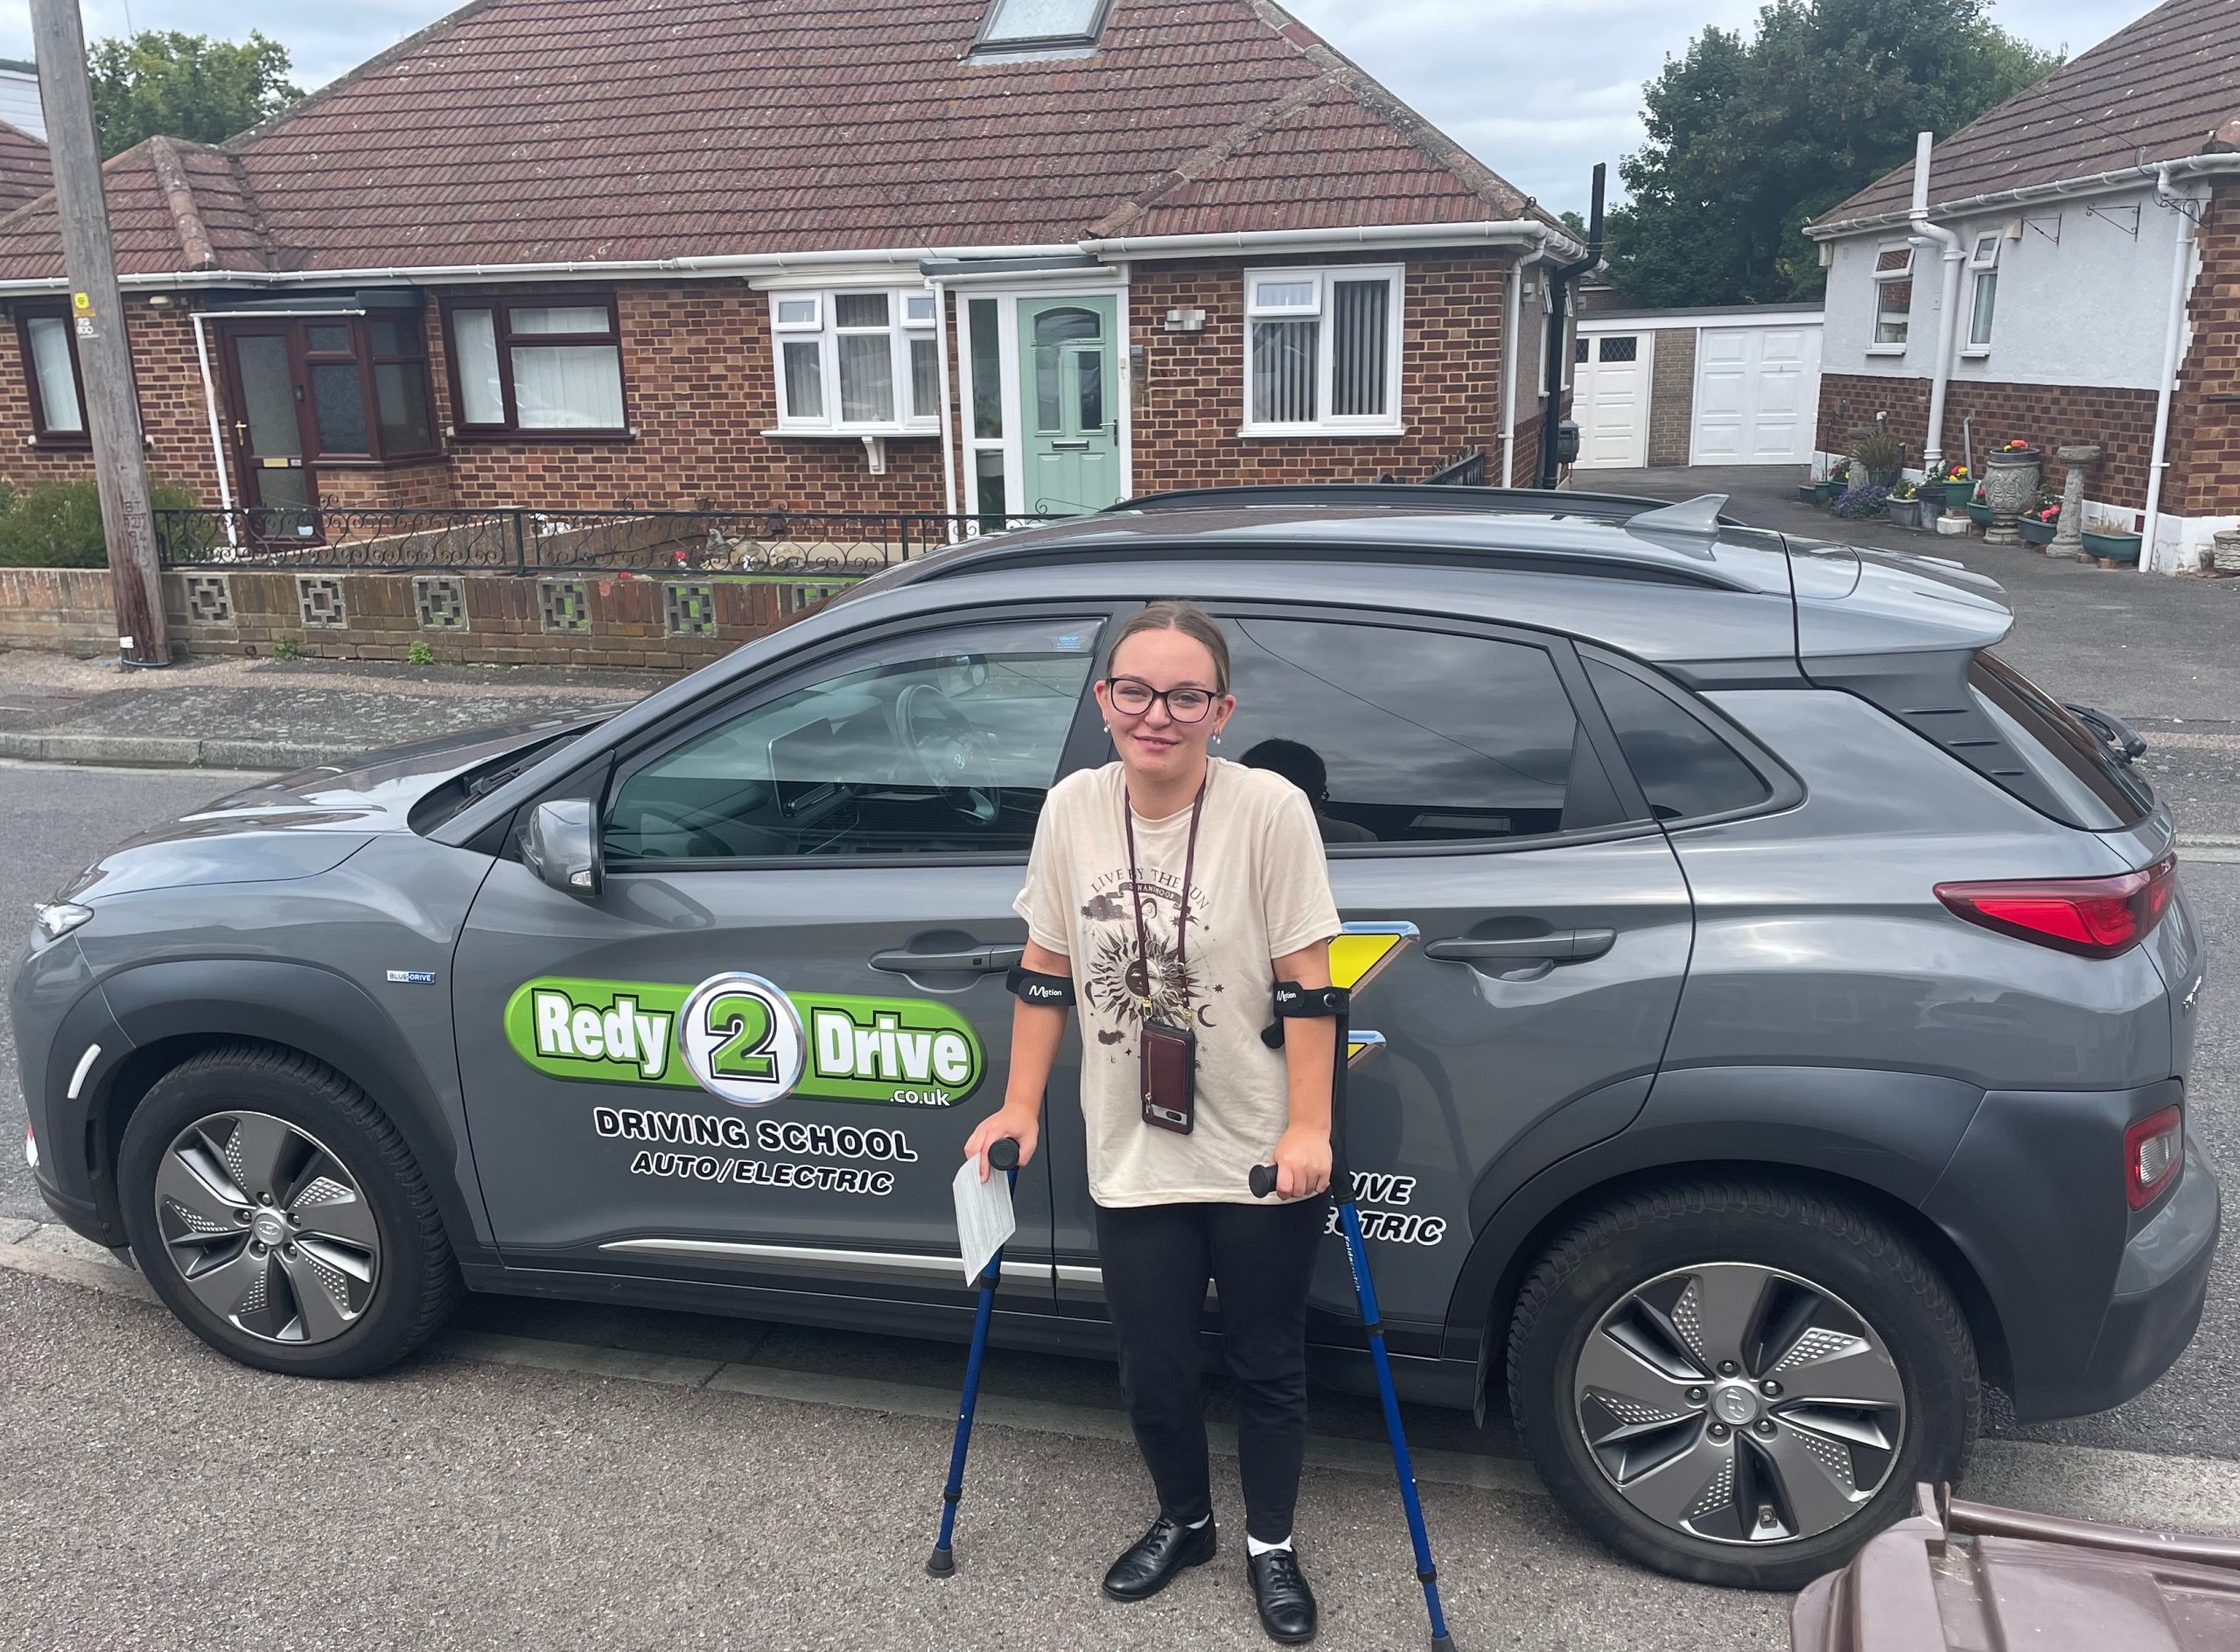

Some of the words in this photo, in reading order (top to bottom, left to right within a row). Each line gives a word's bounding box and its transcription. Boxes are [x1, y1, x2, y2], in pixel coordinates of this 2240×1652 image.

[1091, 868, 1124, 893] LIVE
[1151, 869, 1180, 889] THE
[1182, 882, 1209, 911] UN
[1028, 984, 1062, 998] Motion
[532, 989, 674, 1080] Redy
[705, 990, 780, 1083] 2
[812, 1007, 974, 1086] Drive
[889, 1088, 951, 1107] .co.uk
[594, 1106, 747, 1148] DRIVING
[757, 1120, 918, 1162] SCHOOL
[630, 1152, 894, 1195] AUTO/ELECTRIC
[1350, 1172, 1417, 1205] IVE
